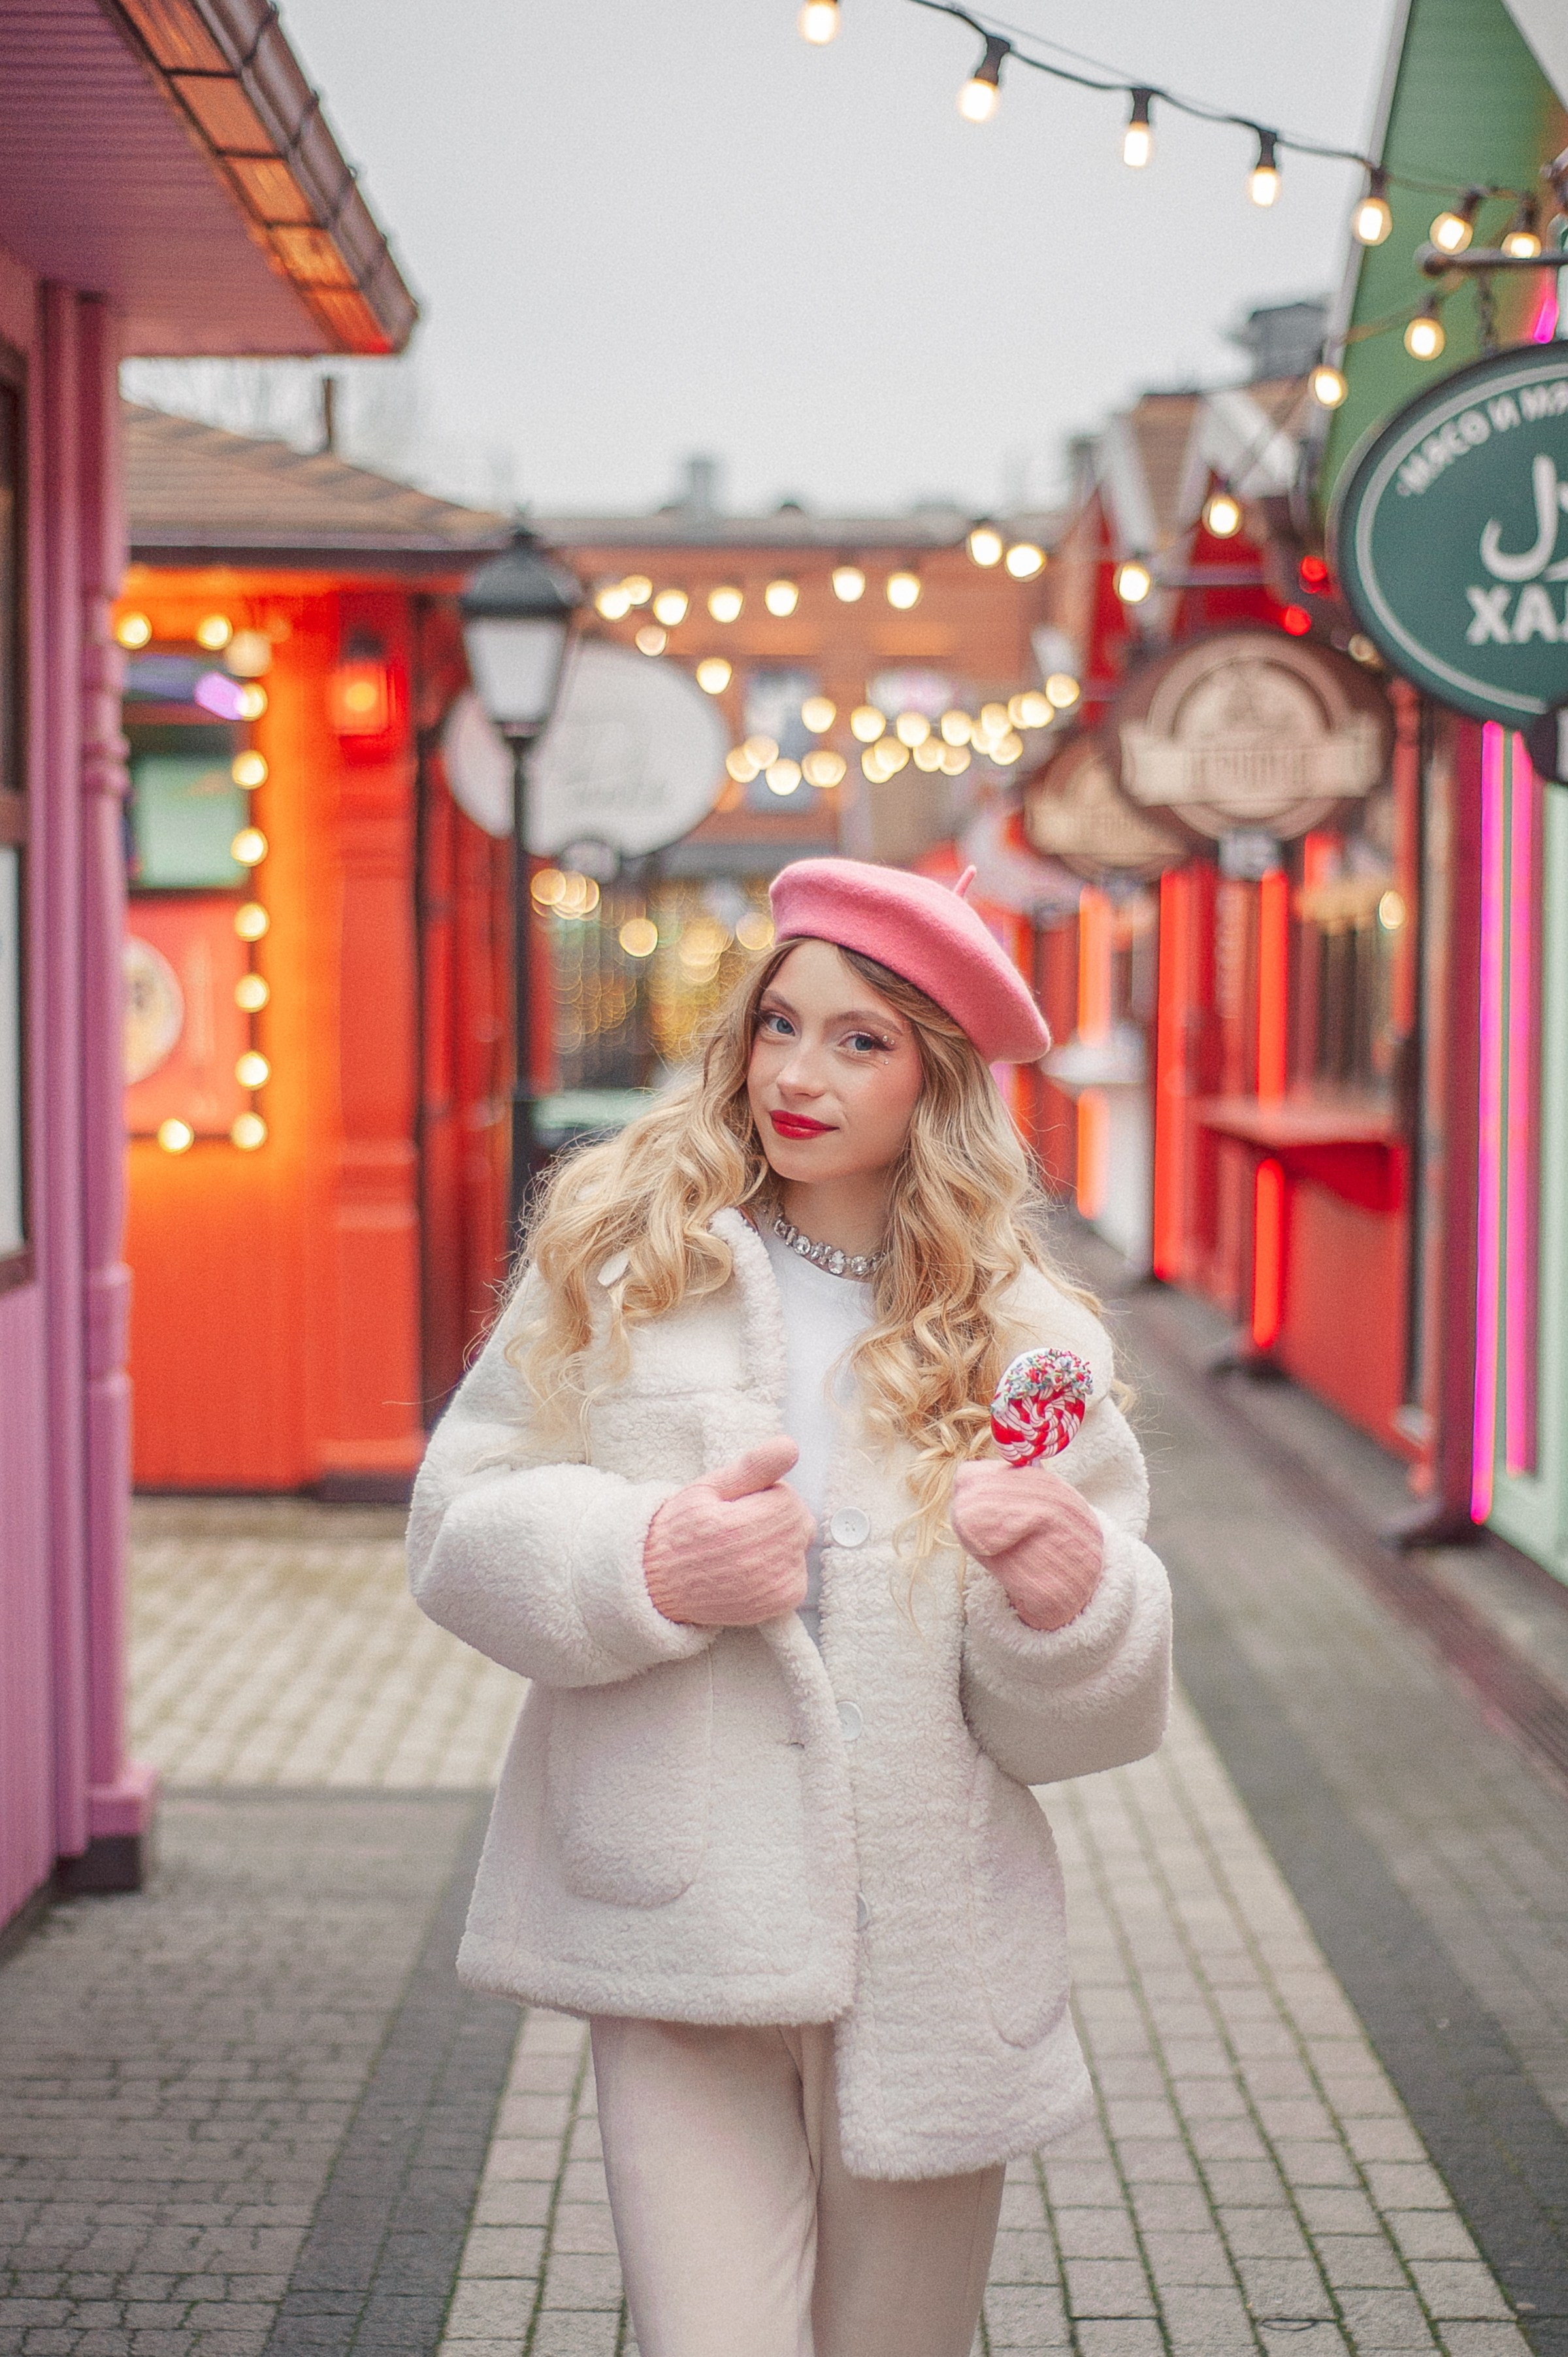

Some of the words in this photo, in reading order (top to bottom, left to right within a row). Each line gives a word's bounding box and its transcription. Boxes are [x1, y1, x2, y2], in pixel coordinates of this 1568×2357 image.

[1398, 410, 1491, 495] МЯСО
[1487, 395, 1521, 432] И
[1466, 584, 1568, 643] ХА
